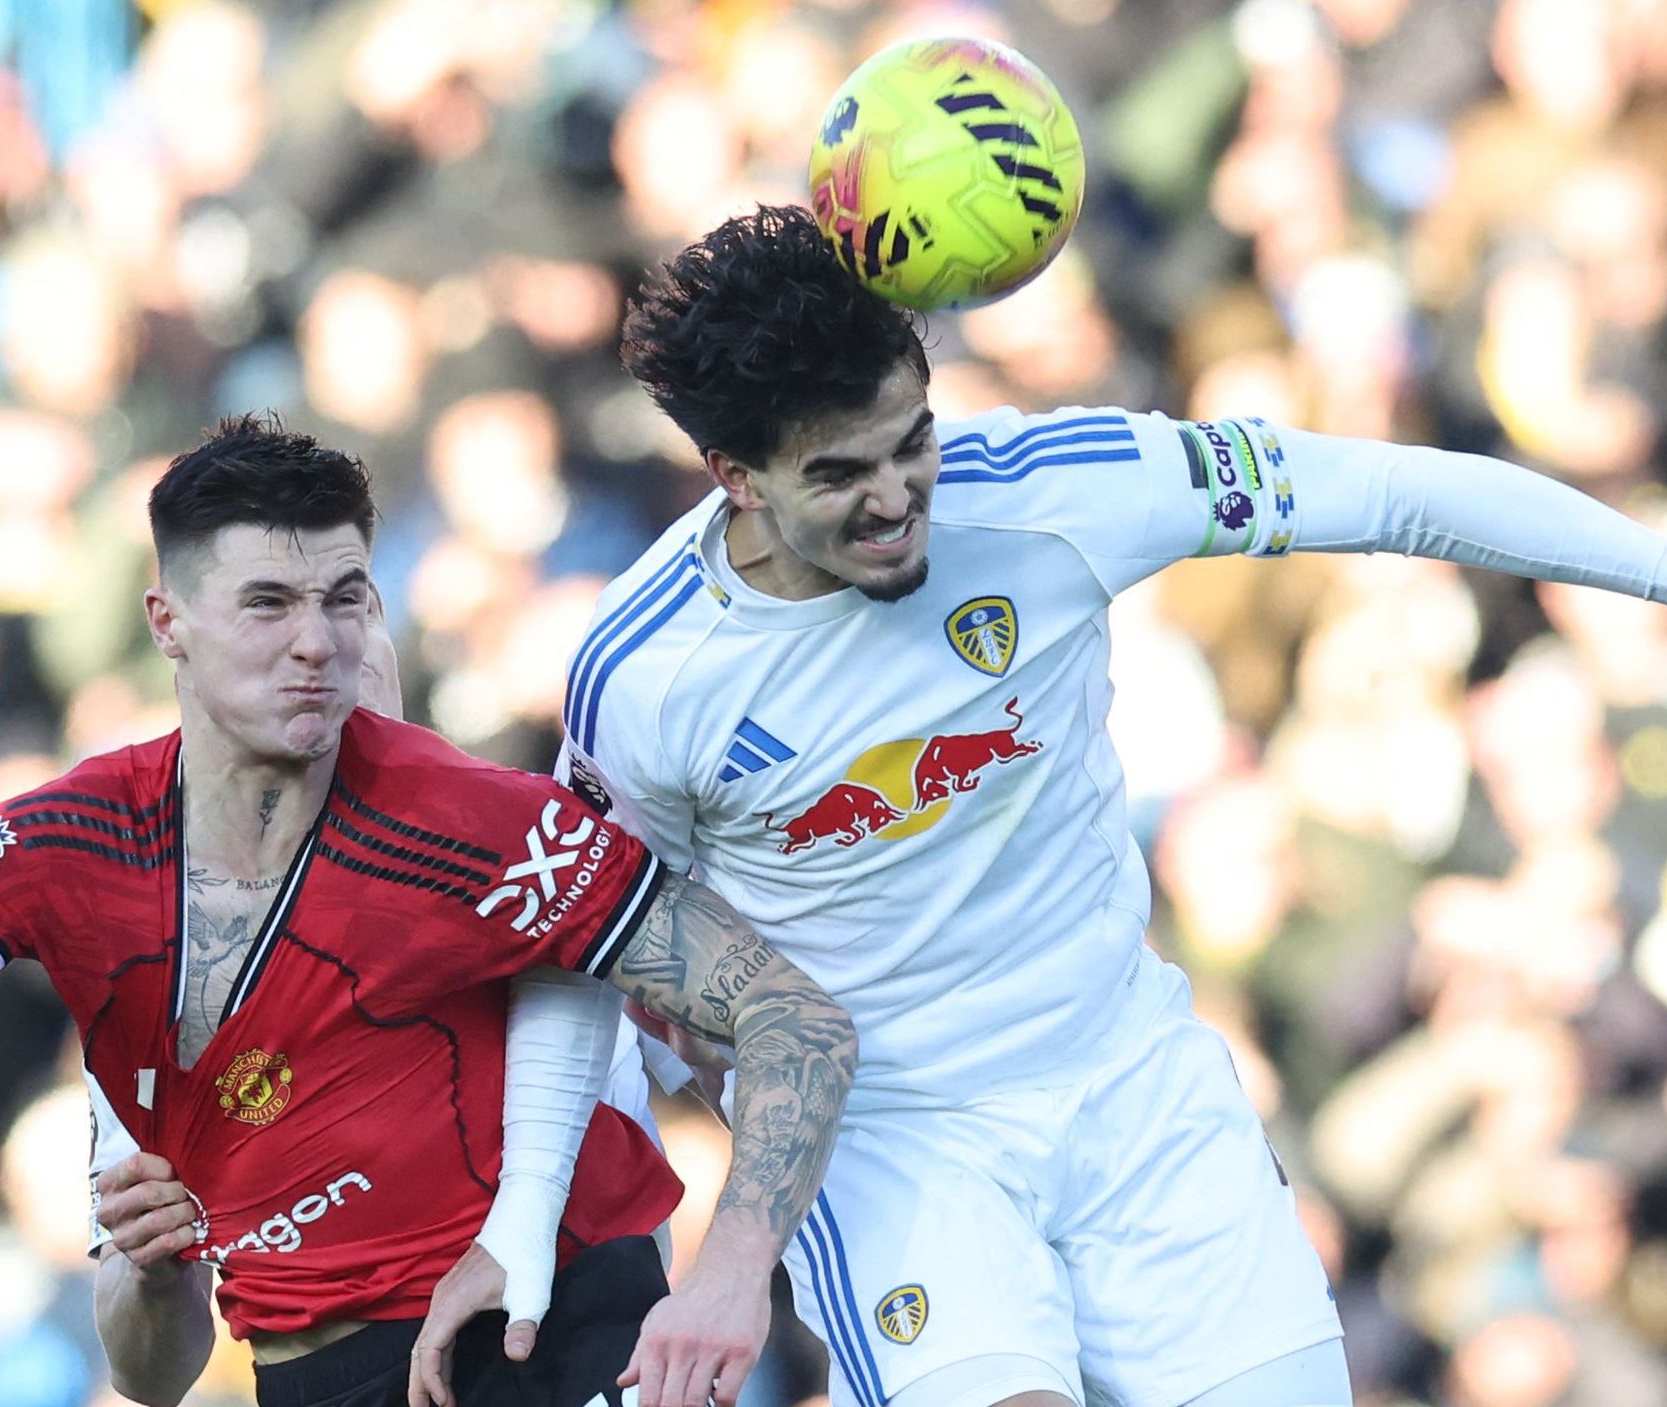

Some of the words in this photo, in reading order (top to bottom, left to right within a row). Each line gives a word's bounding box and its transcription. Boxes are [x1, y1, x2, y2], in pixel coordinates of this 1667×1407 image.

[475, 798, 595, 932] DXC
[526, 826, 614, 939] TECHNOLOGY
[239, 1097, 284, 1120] UNITED
